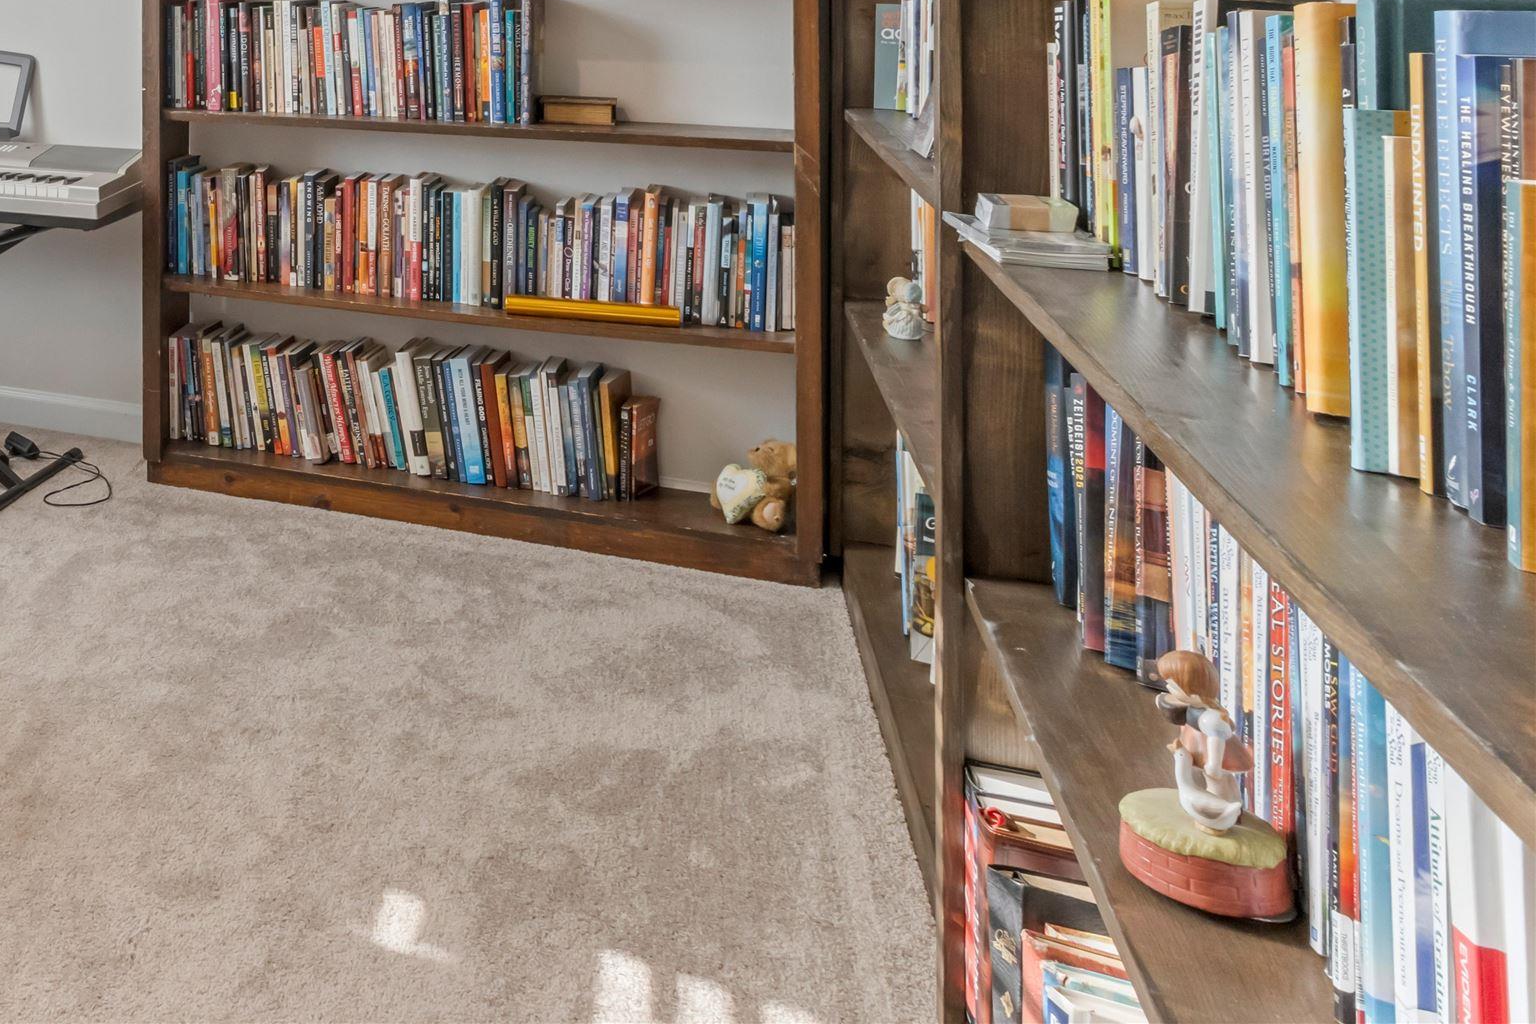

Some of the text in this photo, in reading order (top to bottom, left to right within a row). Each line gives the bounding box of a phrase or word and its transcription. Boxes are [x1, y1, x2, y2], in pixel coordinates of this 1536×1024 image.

[453, 57, 462, 89] HERMON
[1435, 39, 1451, 129] RIPPLE
[1119, 85, 1127, 125] STEPPING
[1262, 135, 1272, 200] DIRTY GOD
[1500, 84, 1512, 196] EYEWITNESS
[382, 186, 390, 212] TAKING
[1410, 103, 1424, 252] UNDAUNTED
[1438, 138, 1453, 256] EFFECTS
[506, 222, 514, 266] OBEDIENCE
[1460, 97, 1478, 433] THE HEALING BREAKTHROUGH CLARK
[474, 378, 484, 405] FILMING
[478, 406, 486, 422] GOD
[1209, 527, 1217, 583] PARTING
[1210, 602, 1219, 658] WATERS
[1271, 581, 1286, 767] EAL STORIES
[1323, 644, 1331, 709] MODELS
[1329, 675, 1339, 716] SAW
[1329, 724, 1337, 773] GOD
[1429, 807, 1443, 898] Attitude
